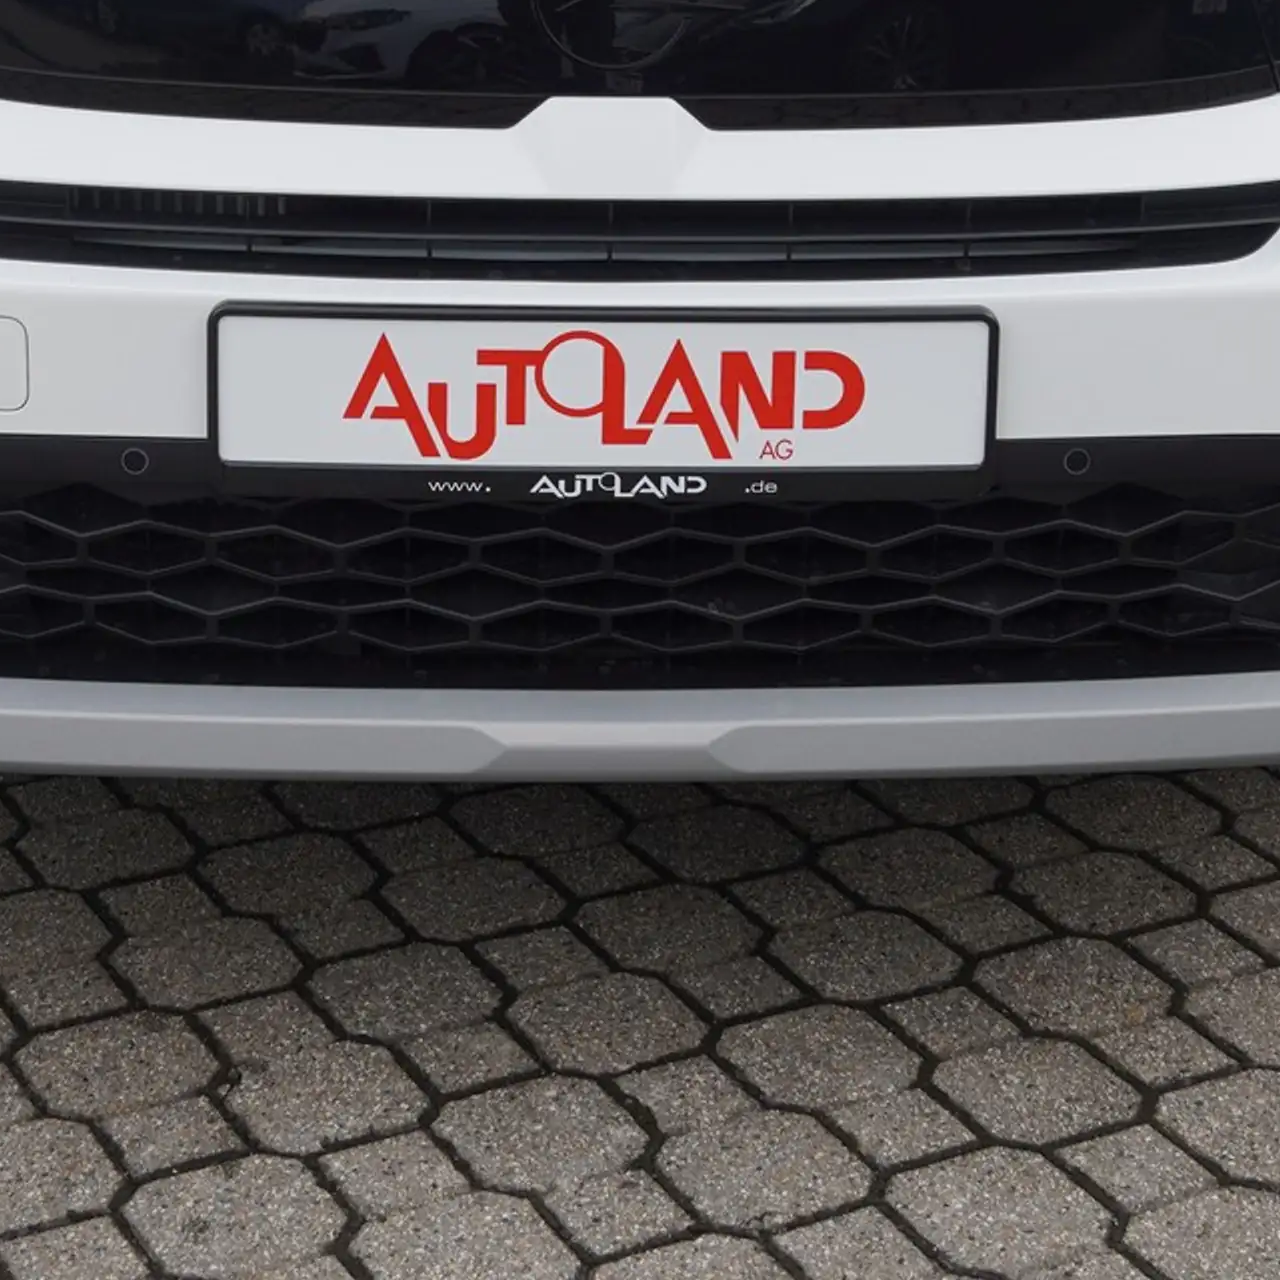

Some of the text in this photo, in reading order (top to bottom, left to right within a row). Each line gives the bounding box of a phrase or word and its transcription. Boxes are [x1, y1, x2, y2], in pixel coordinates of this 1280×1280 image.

[342, 330, 866, 460] AUTOLAND
[759, 440, 794, 462] AG
[428, 472, 778, 499] www. AUTOLAND .de
